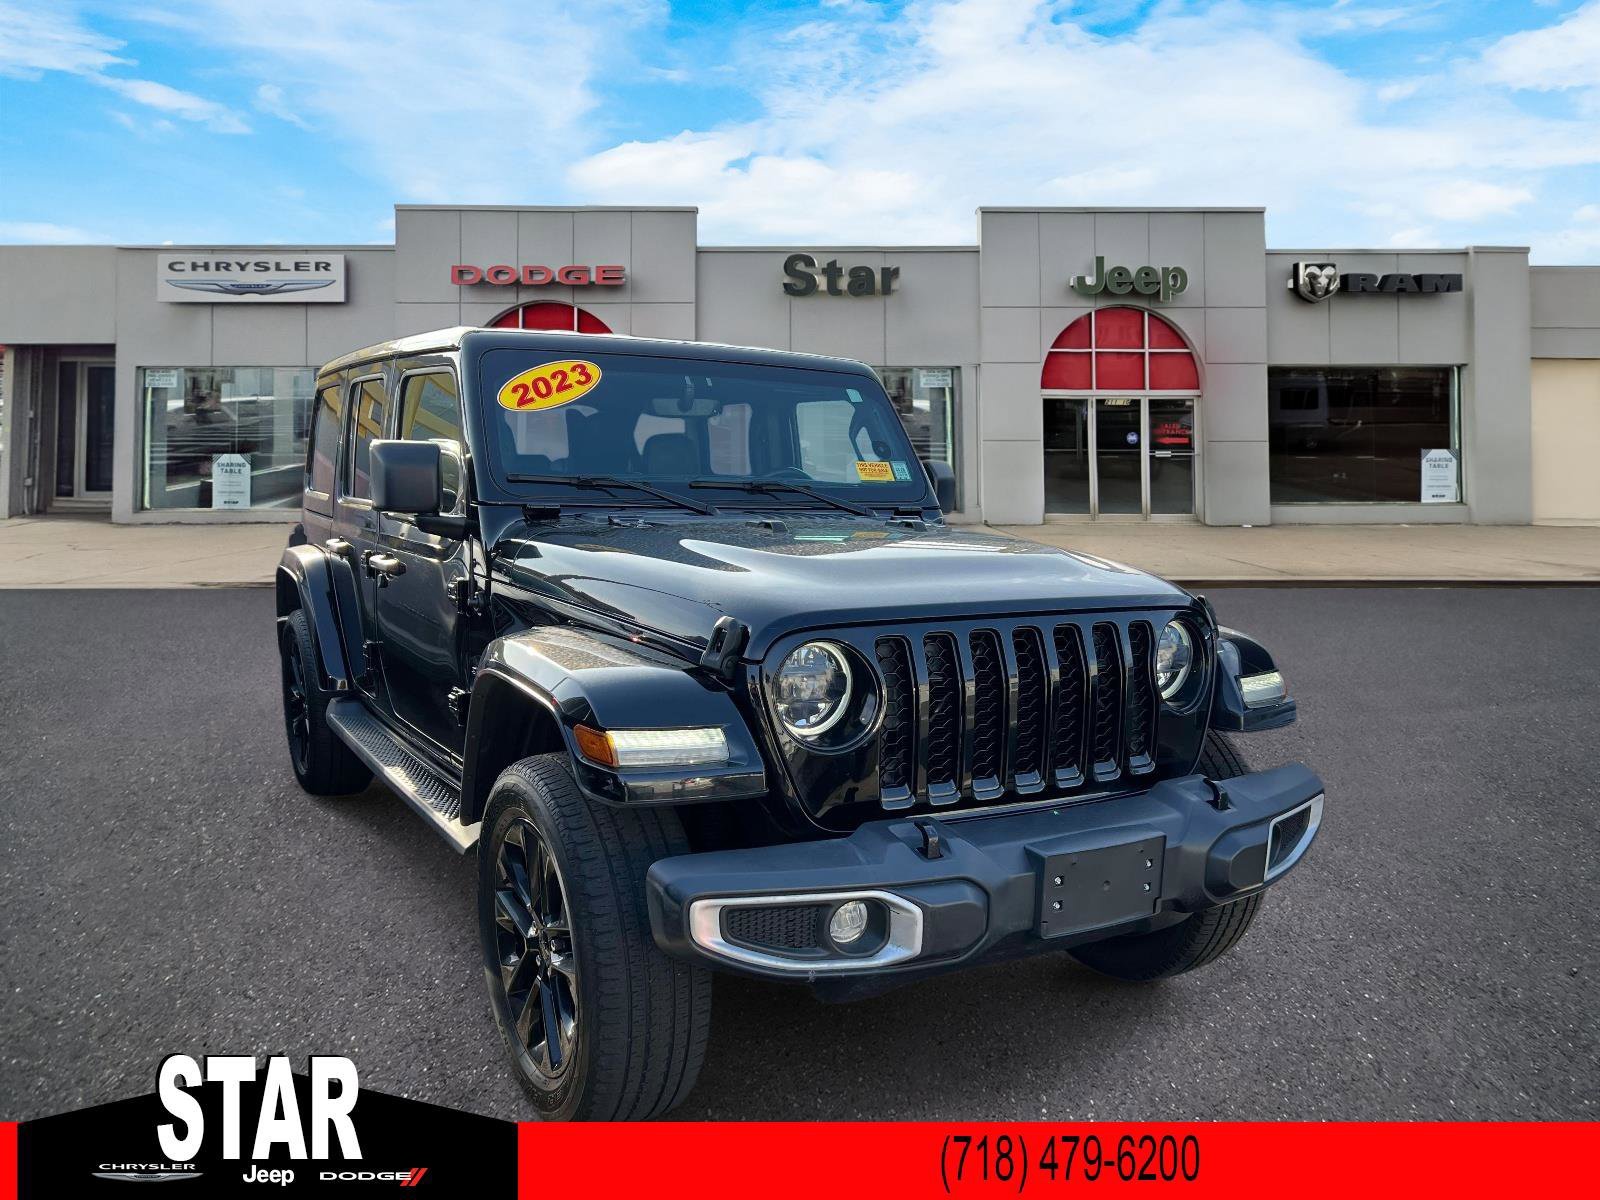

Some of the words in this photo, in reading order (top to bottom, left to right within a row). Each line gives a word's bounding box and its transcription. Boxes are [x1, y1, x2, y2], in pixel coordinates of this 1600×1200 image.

[167, 260, 332, 273] CHRYSLER
[451, 264, 626, 286] DODGE
[783, 253, 900, 297] Star
[1070, 256, 1188, 302] Jeep
[1341, 273, 1463, 293] RAM
[511, 363, 593, 408] 2023
